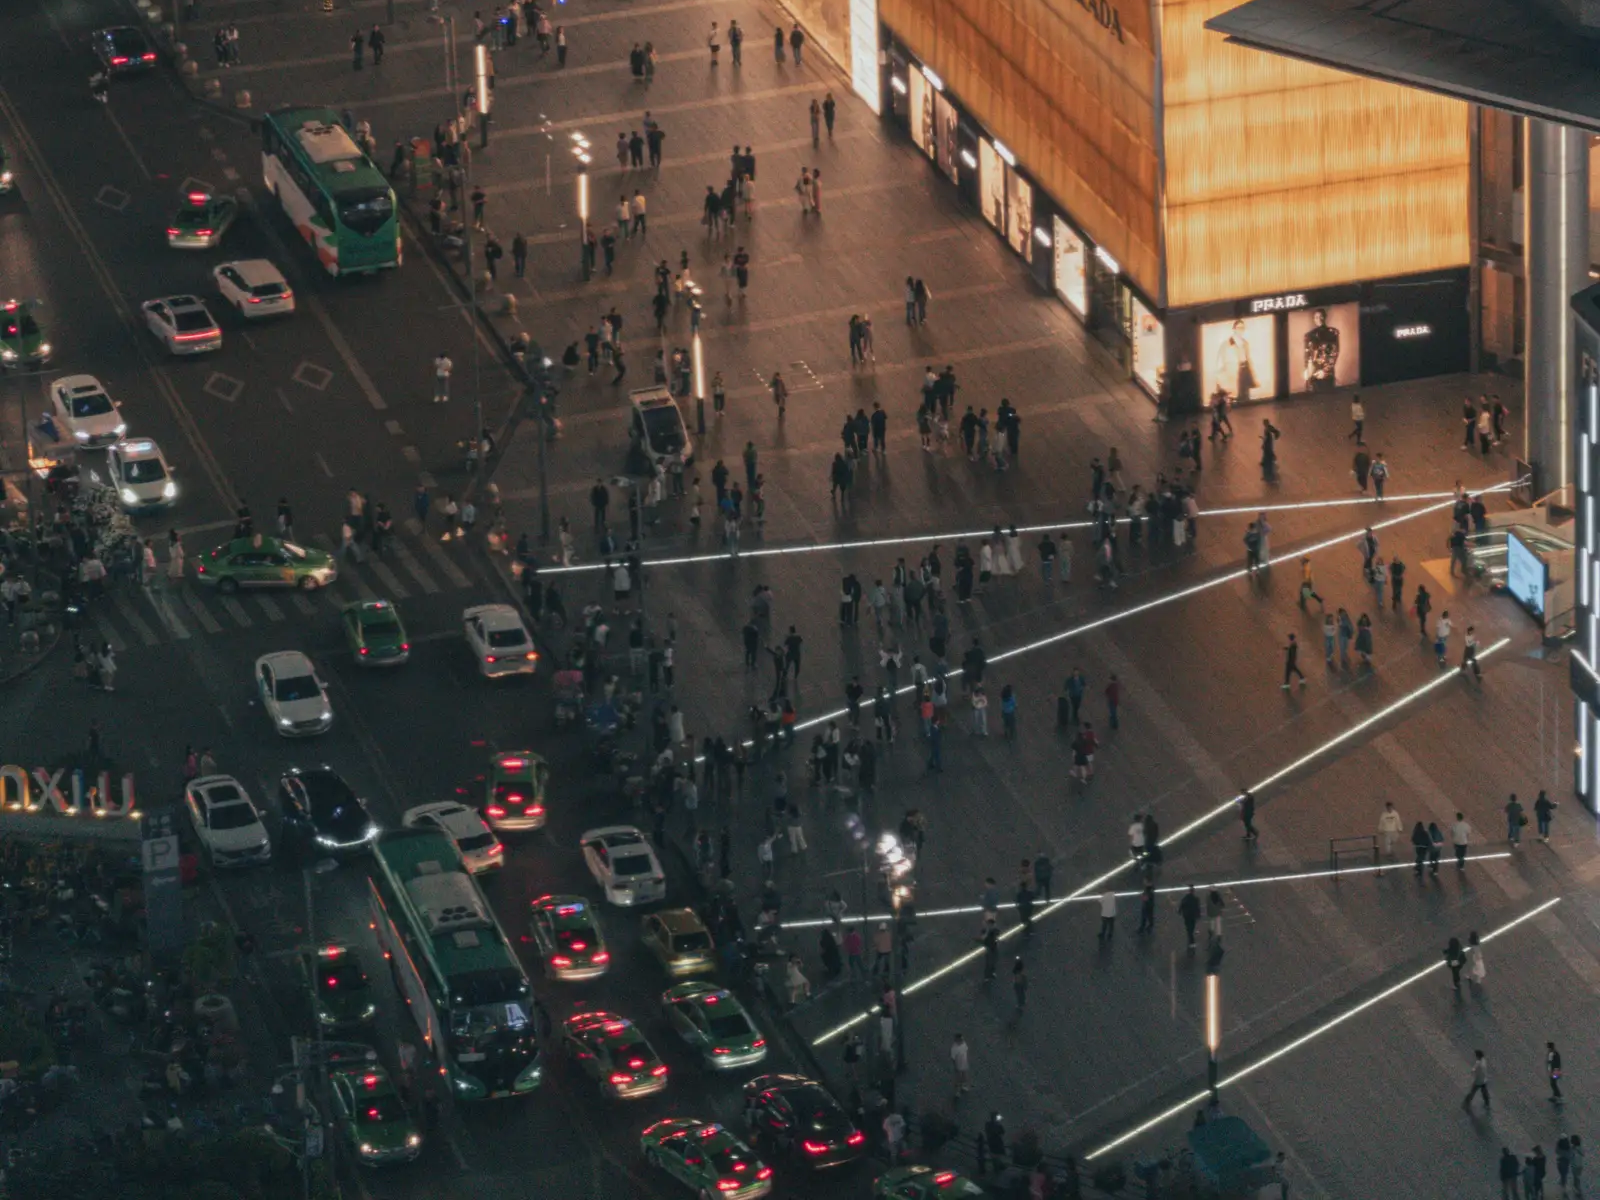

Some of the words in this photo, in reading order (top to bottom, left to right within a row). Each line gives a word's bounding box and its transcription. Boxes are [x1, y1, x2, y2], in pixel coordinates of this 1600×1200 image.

[1252, 294, 1308, 313] PRADA
[1396, 326, 1431, 338] PRADA
[151, 840, 172, 866] P
